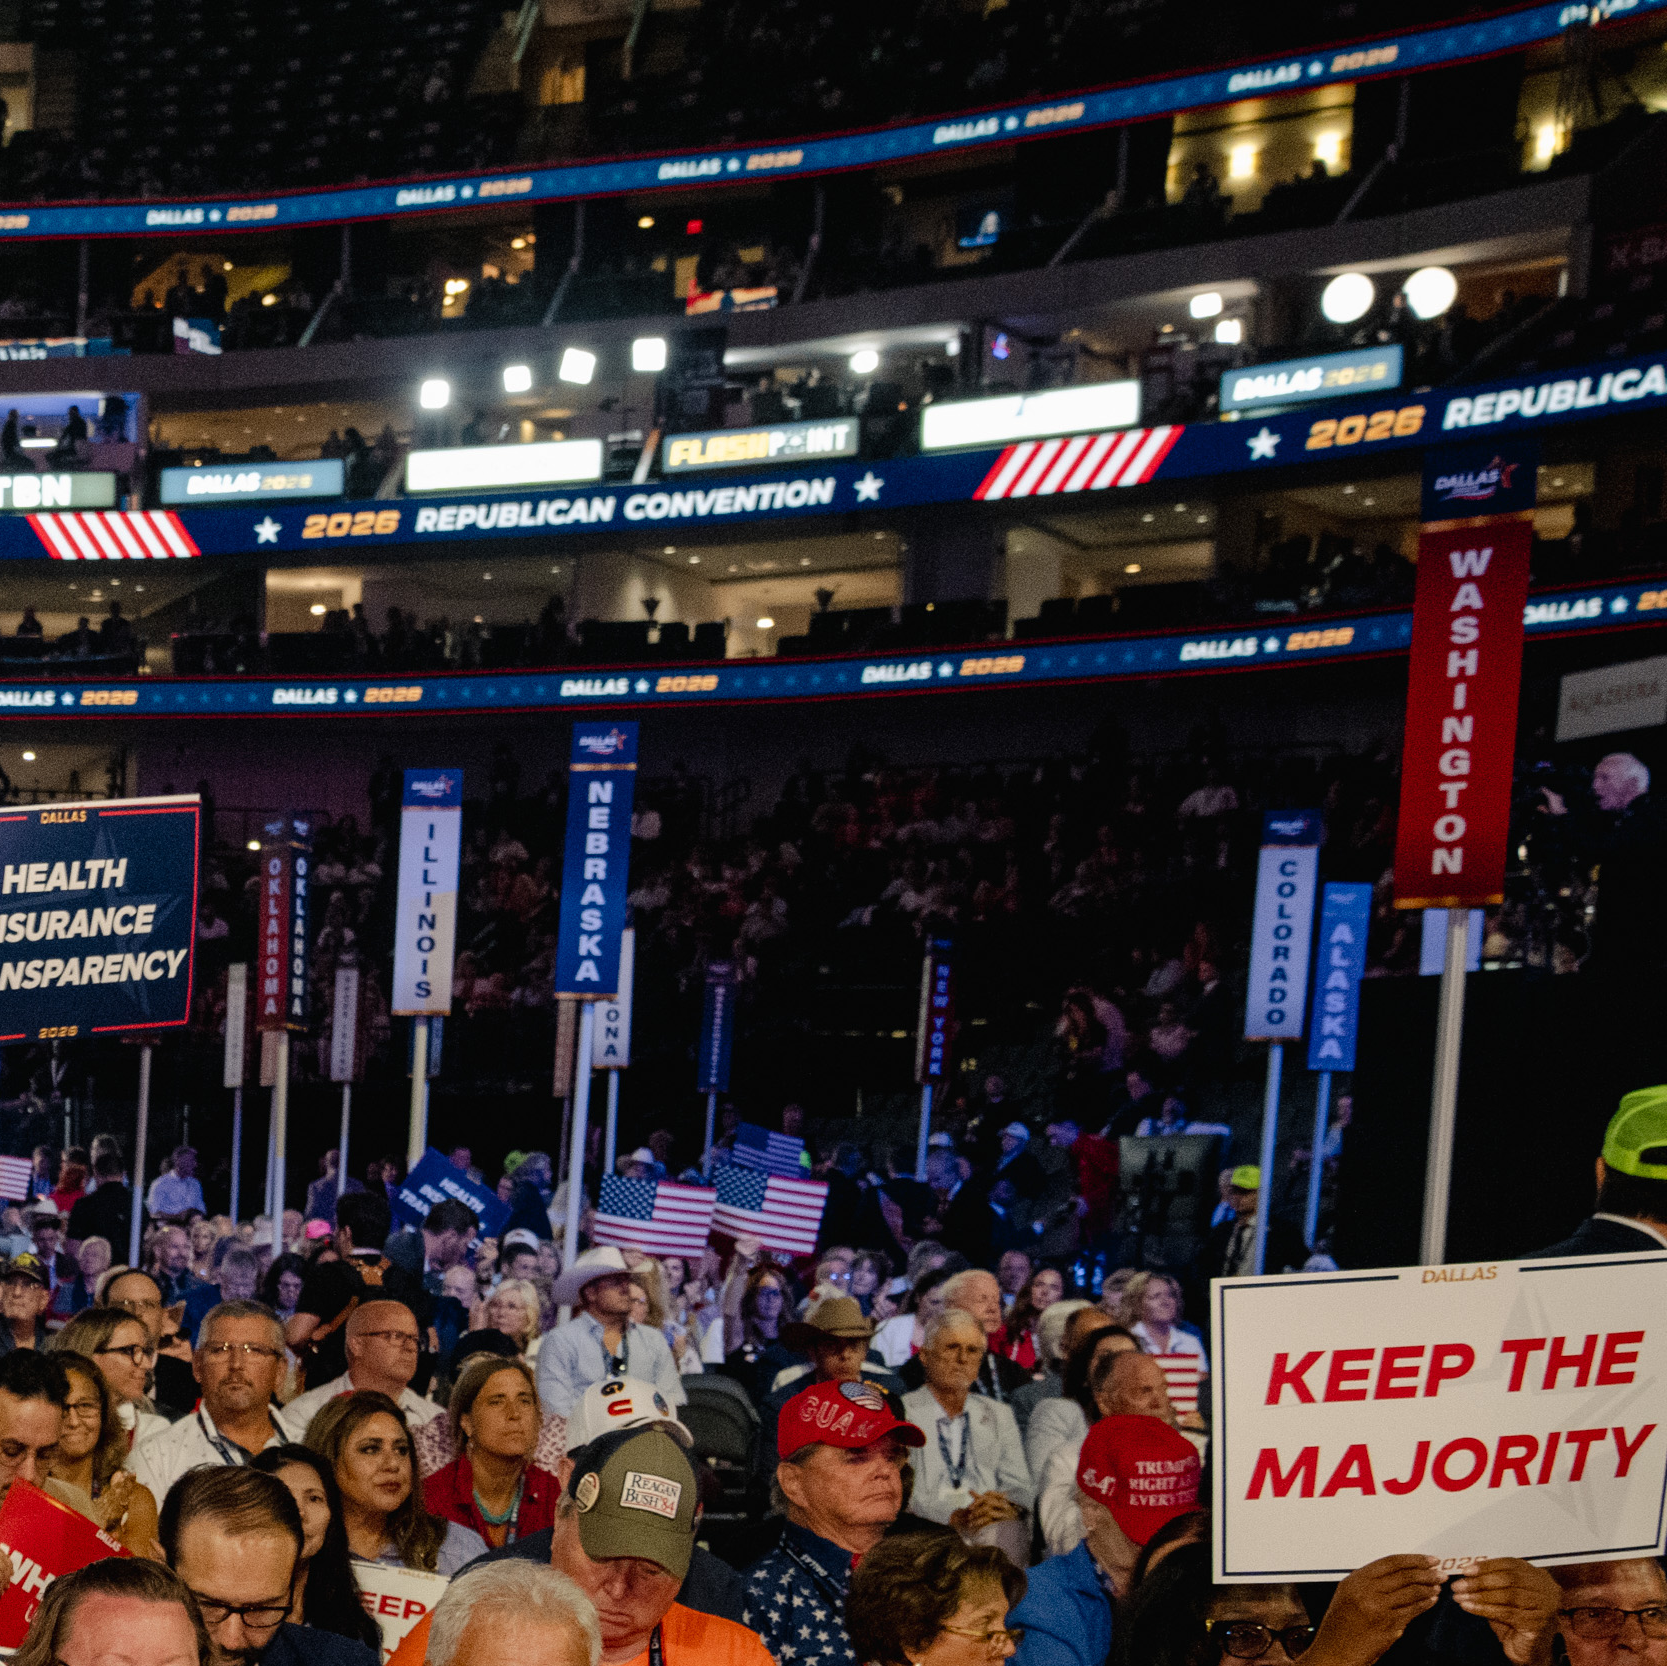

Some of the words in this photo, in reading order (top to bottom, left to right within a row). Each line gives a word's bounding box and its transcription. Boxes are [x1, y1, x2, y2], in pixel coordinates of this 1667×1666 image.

[302, 510, 401, 538] 2026
[416, 497, 616, 532] REPUBLICAN
[624, 469, 835, 520] CONVENTION
[561, 678, 628, 696] DALLAS
[1430, 547, 1494, 876] WASHINGTON
[41, 811, 87, 823] DALLAS
[2, 858, 128, 895] HEALTH
[414, 823, 438, 999] ILLINOIS
[574, 779, 613, 983] NEBRASKA
[267, 857, 280, 1016] OKLAHOMA
[294, 857, 309, 1016] OKLAHOMA
[1266, 860, 1297, 1026] COLORADO
[1317, 921, 1356, 1060] ALASKA
[39, 1026, 77, 1038] 2026
[1421, 1265, 1498, 1285] DALLAS
[1264, 1343, 1474, 1407] KEEP
[1500, 1329, 1645, 1391] THE
[627, 1486, 659, 1508] BUSH
[632, 1472, 679, 1500] REAGAN
[1245, 1422, 1658, 1501] MAJORITY
